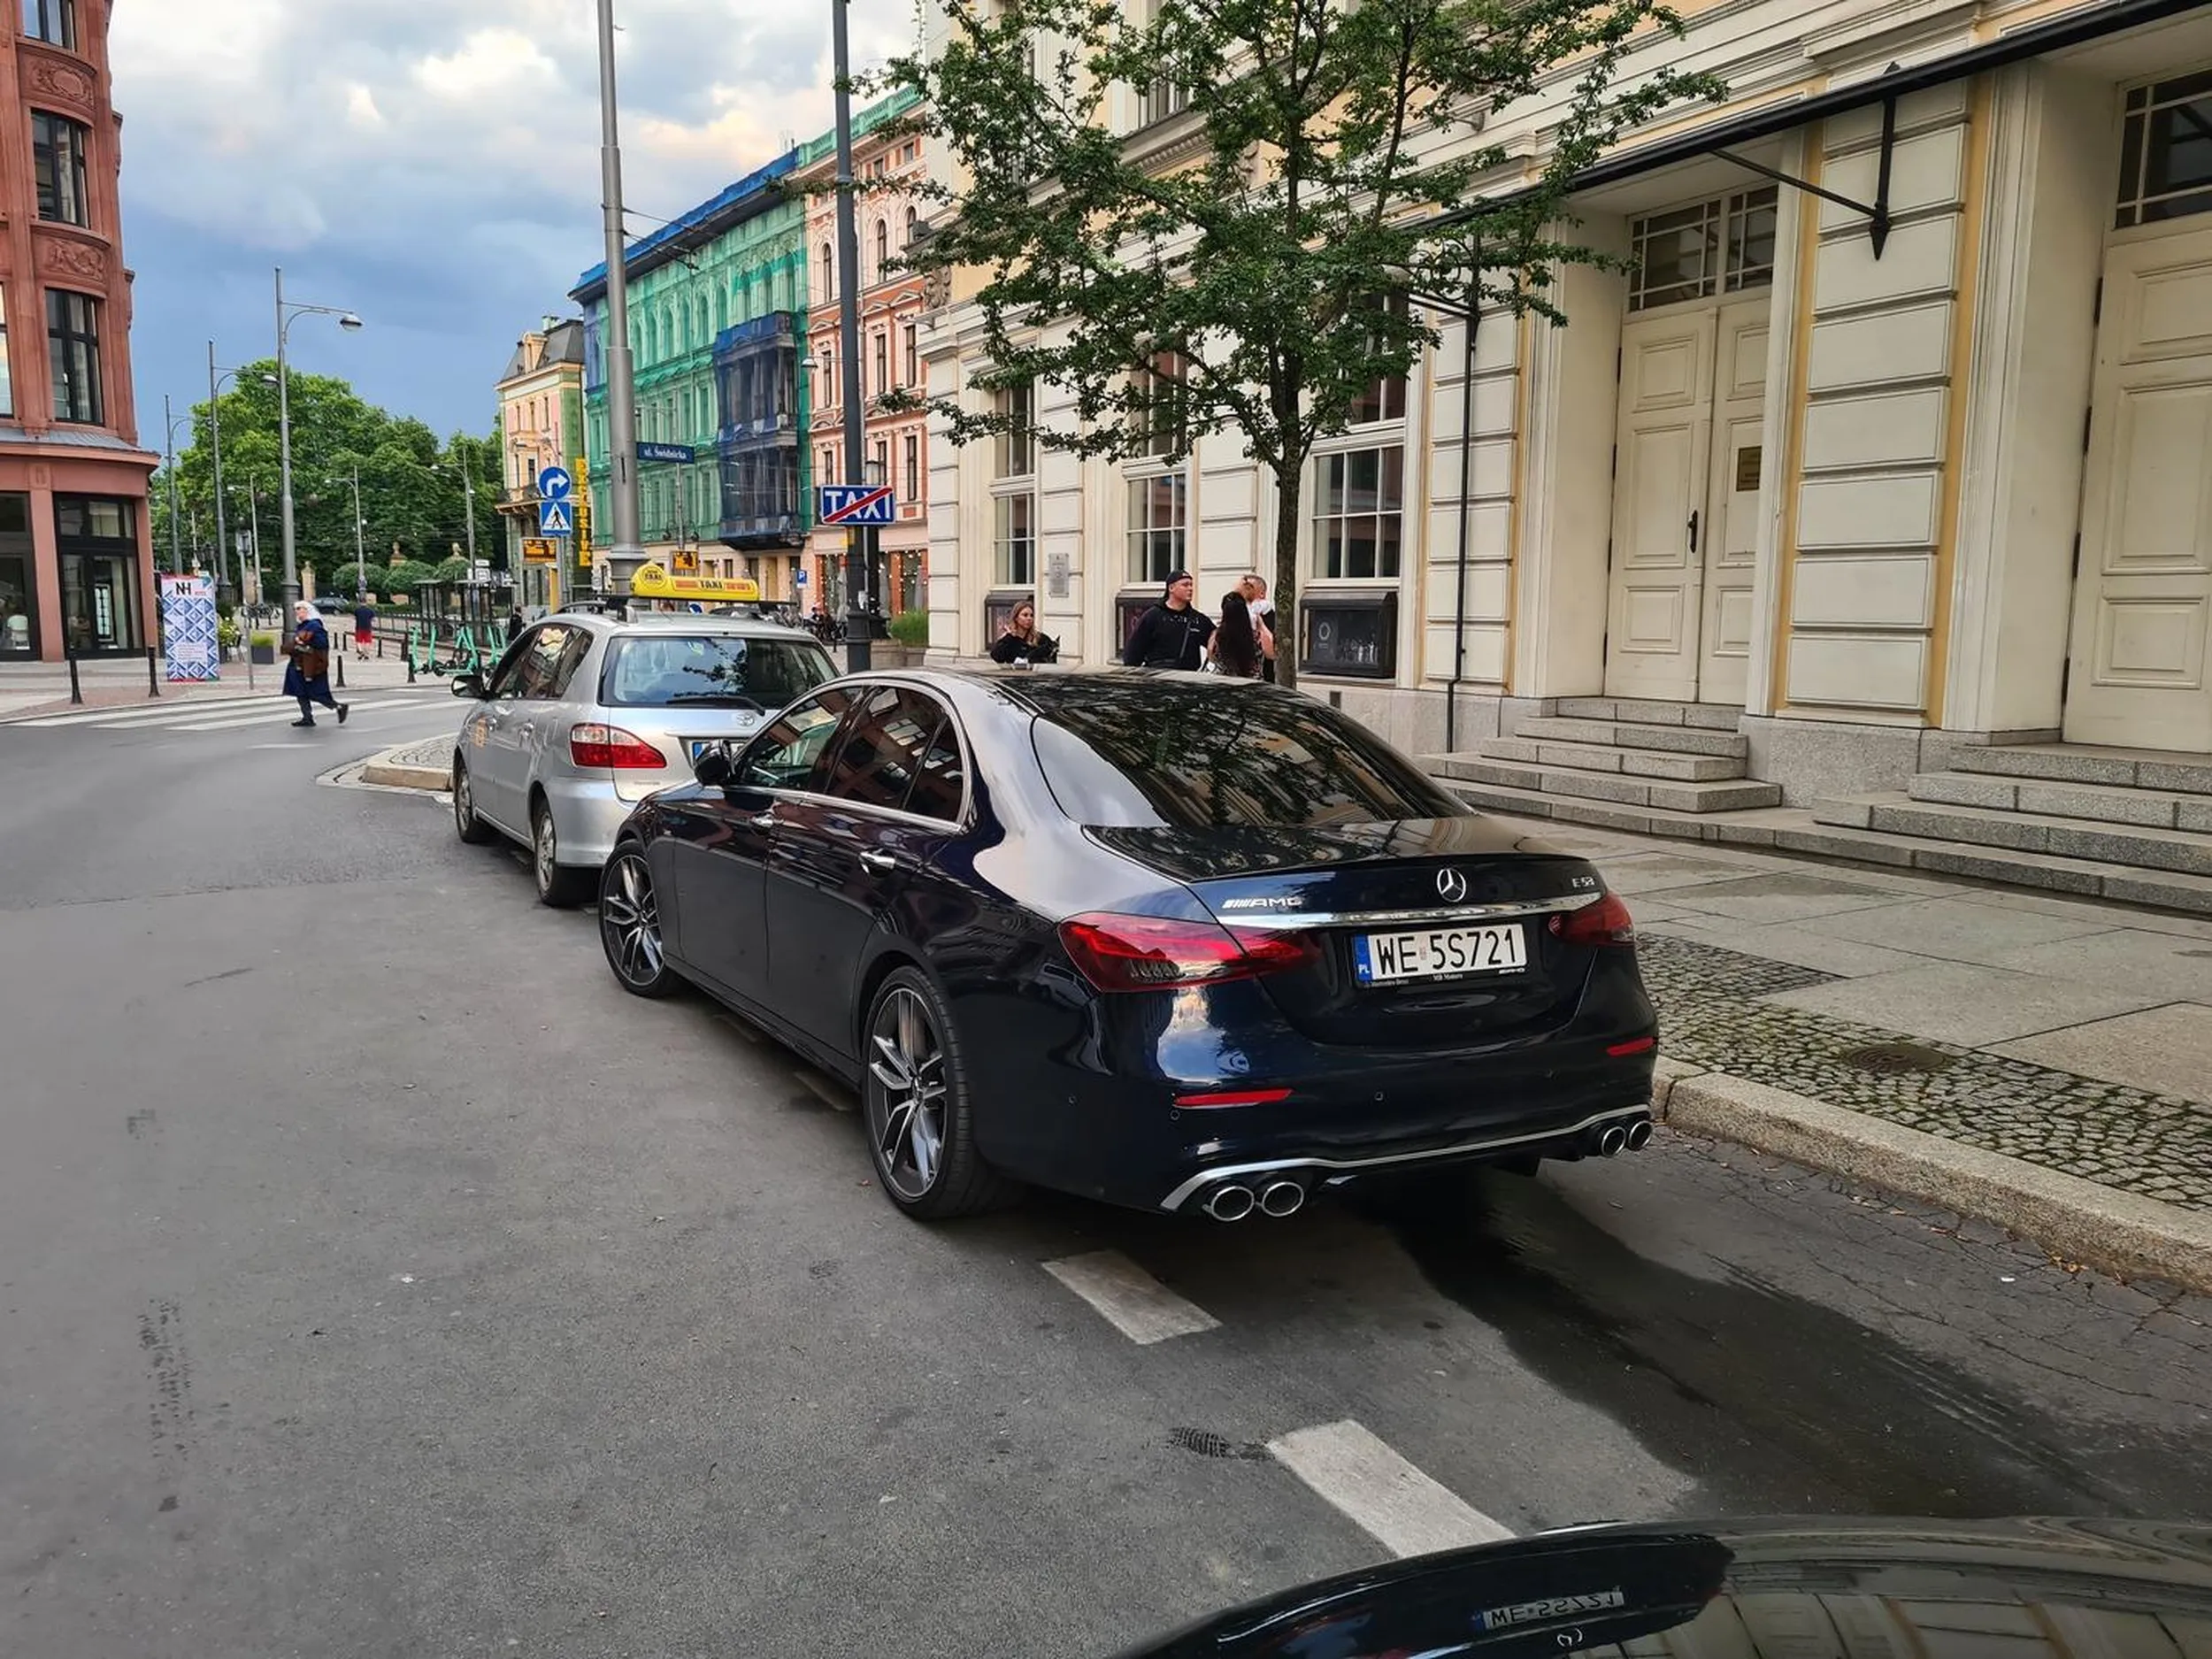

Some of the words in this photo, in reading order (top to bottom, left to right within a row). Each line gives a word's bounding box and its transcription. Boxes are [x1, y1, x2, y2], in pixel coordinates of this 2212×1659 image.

[825, 491, 890, 518] TAXI
[700, 580, 723, 590] TAXI
[1248, 896, 1302, 908] AMG
[1377, 936, 1418, 975] WE
[1429, 929, 1516, 970] 5S721
[1358, 964, 1370, 974] PL
